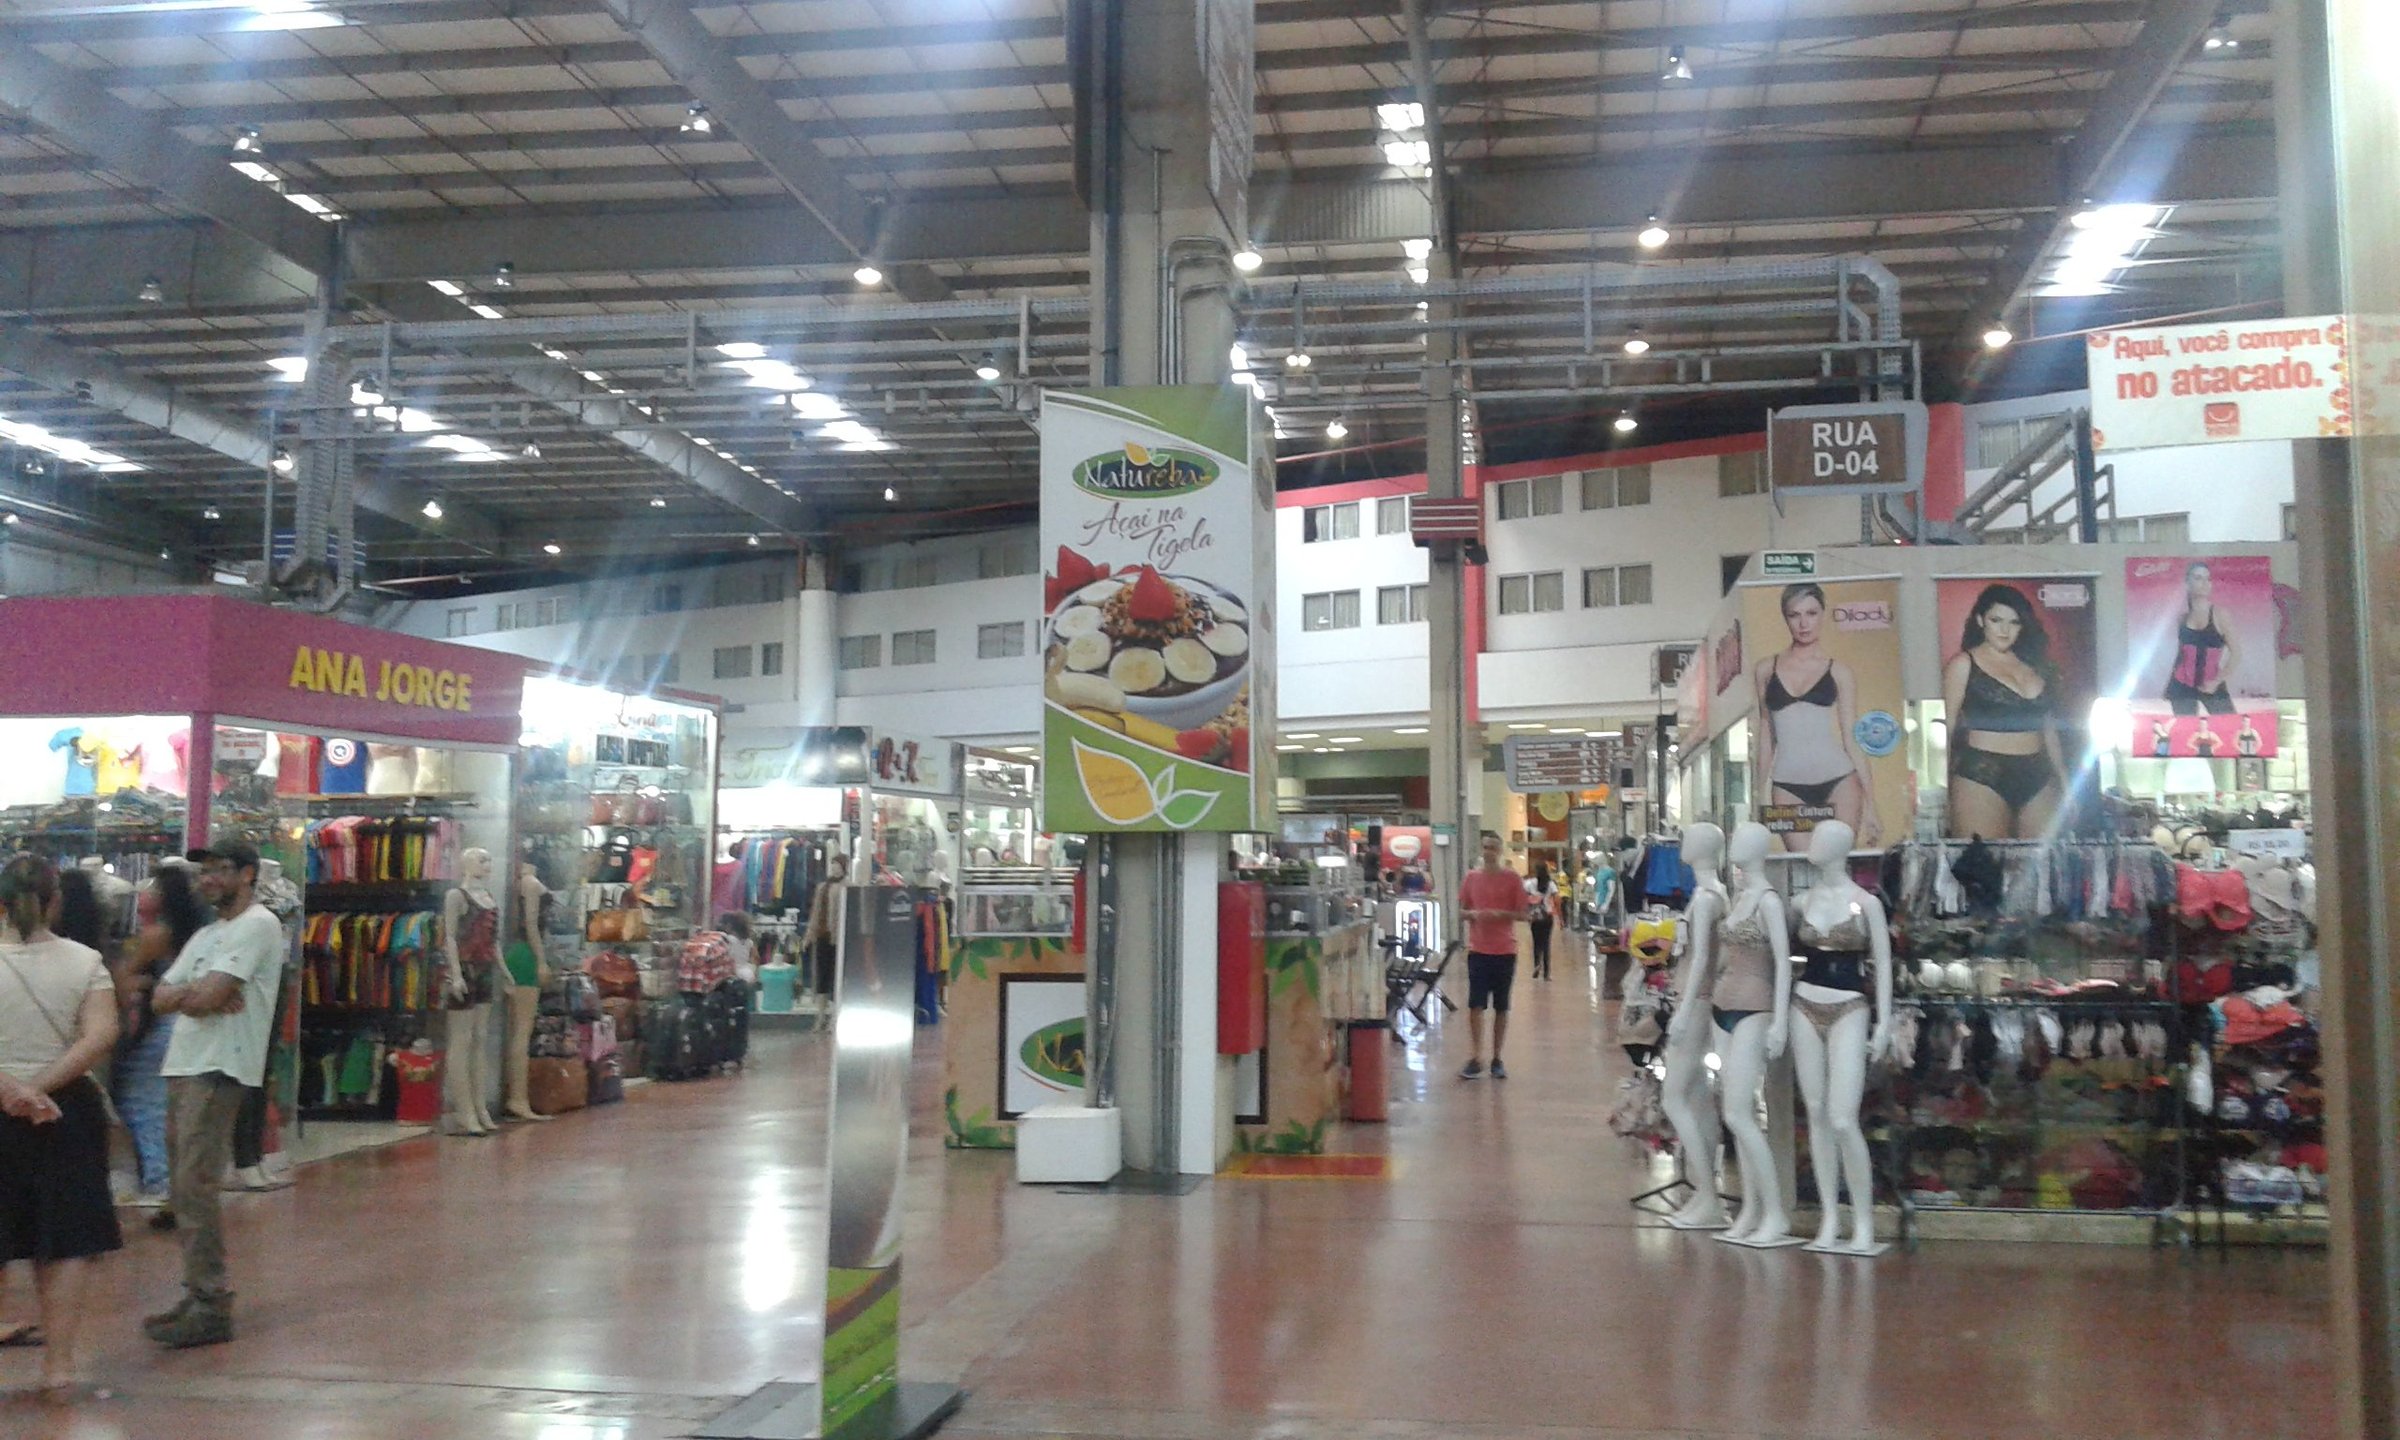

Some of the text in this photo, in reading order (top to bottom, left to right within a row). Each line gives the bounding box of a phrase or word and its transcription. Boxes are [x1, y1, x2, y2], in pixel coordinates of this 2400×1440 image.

[2114, 326, 2321, 361] Aqui, você compra
[2116, 356, 2323, 400] no atacado.
[1812, 421, 1878, 447] RUA
[1083, 456, 1200, 489] Natureba
[1814, 451, 1879, 477] D-04
[1158, 506, 1185, 524] na
[1129, 517, 1214, 571] Tigela
[289, 646, 472, 713] ANA JORGE
